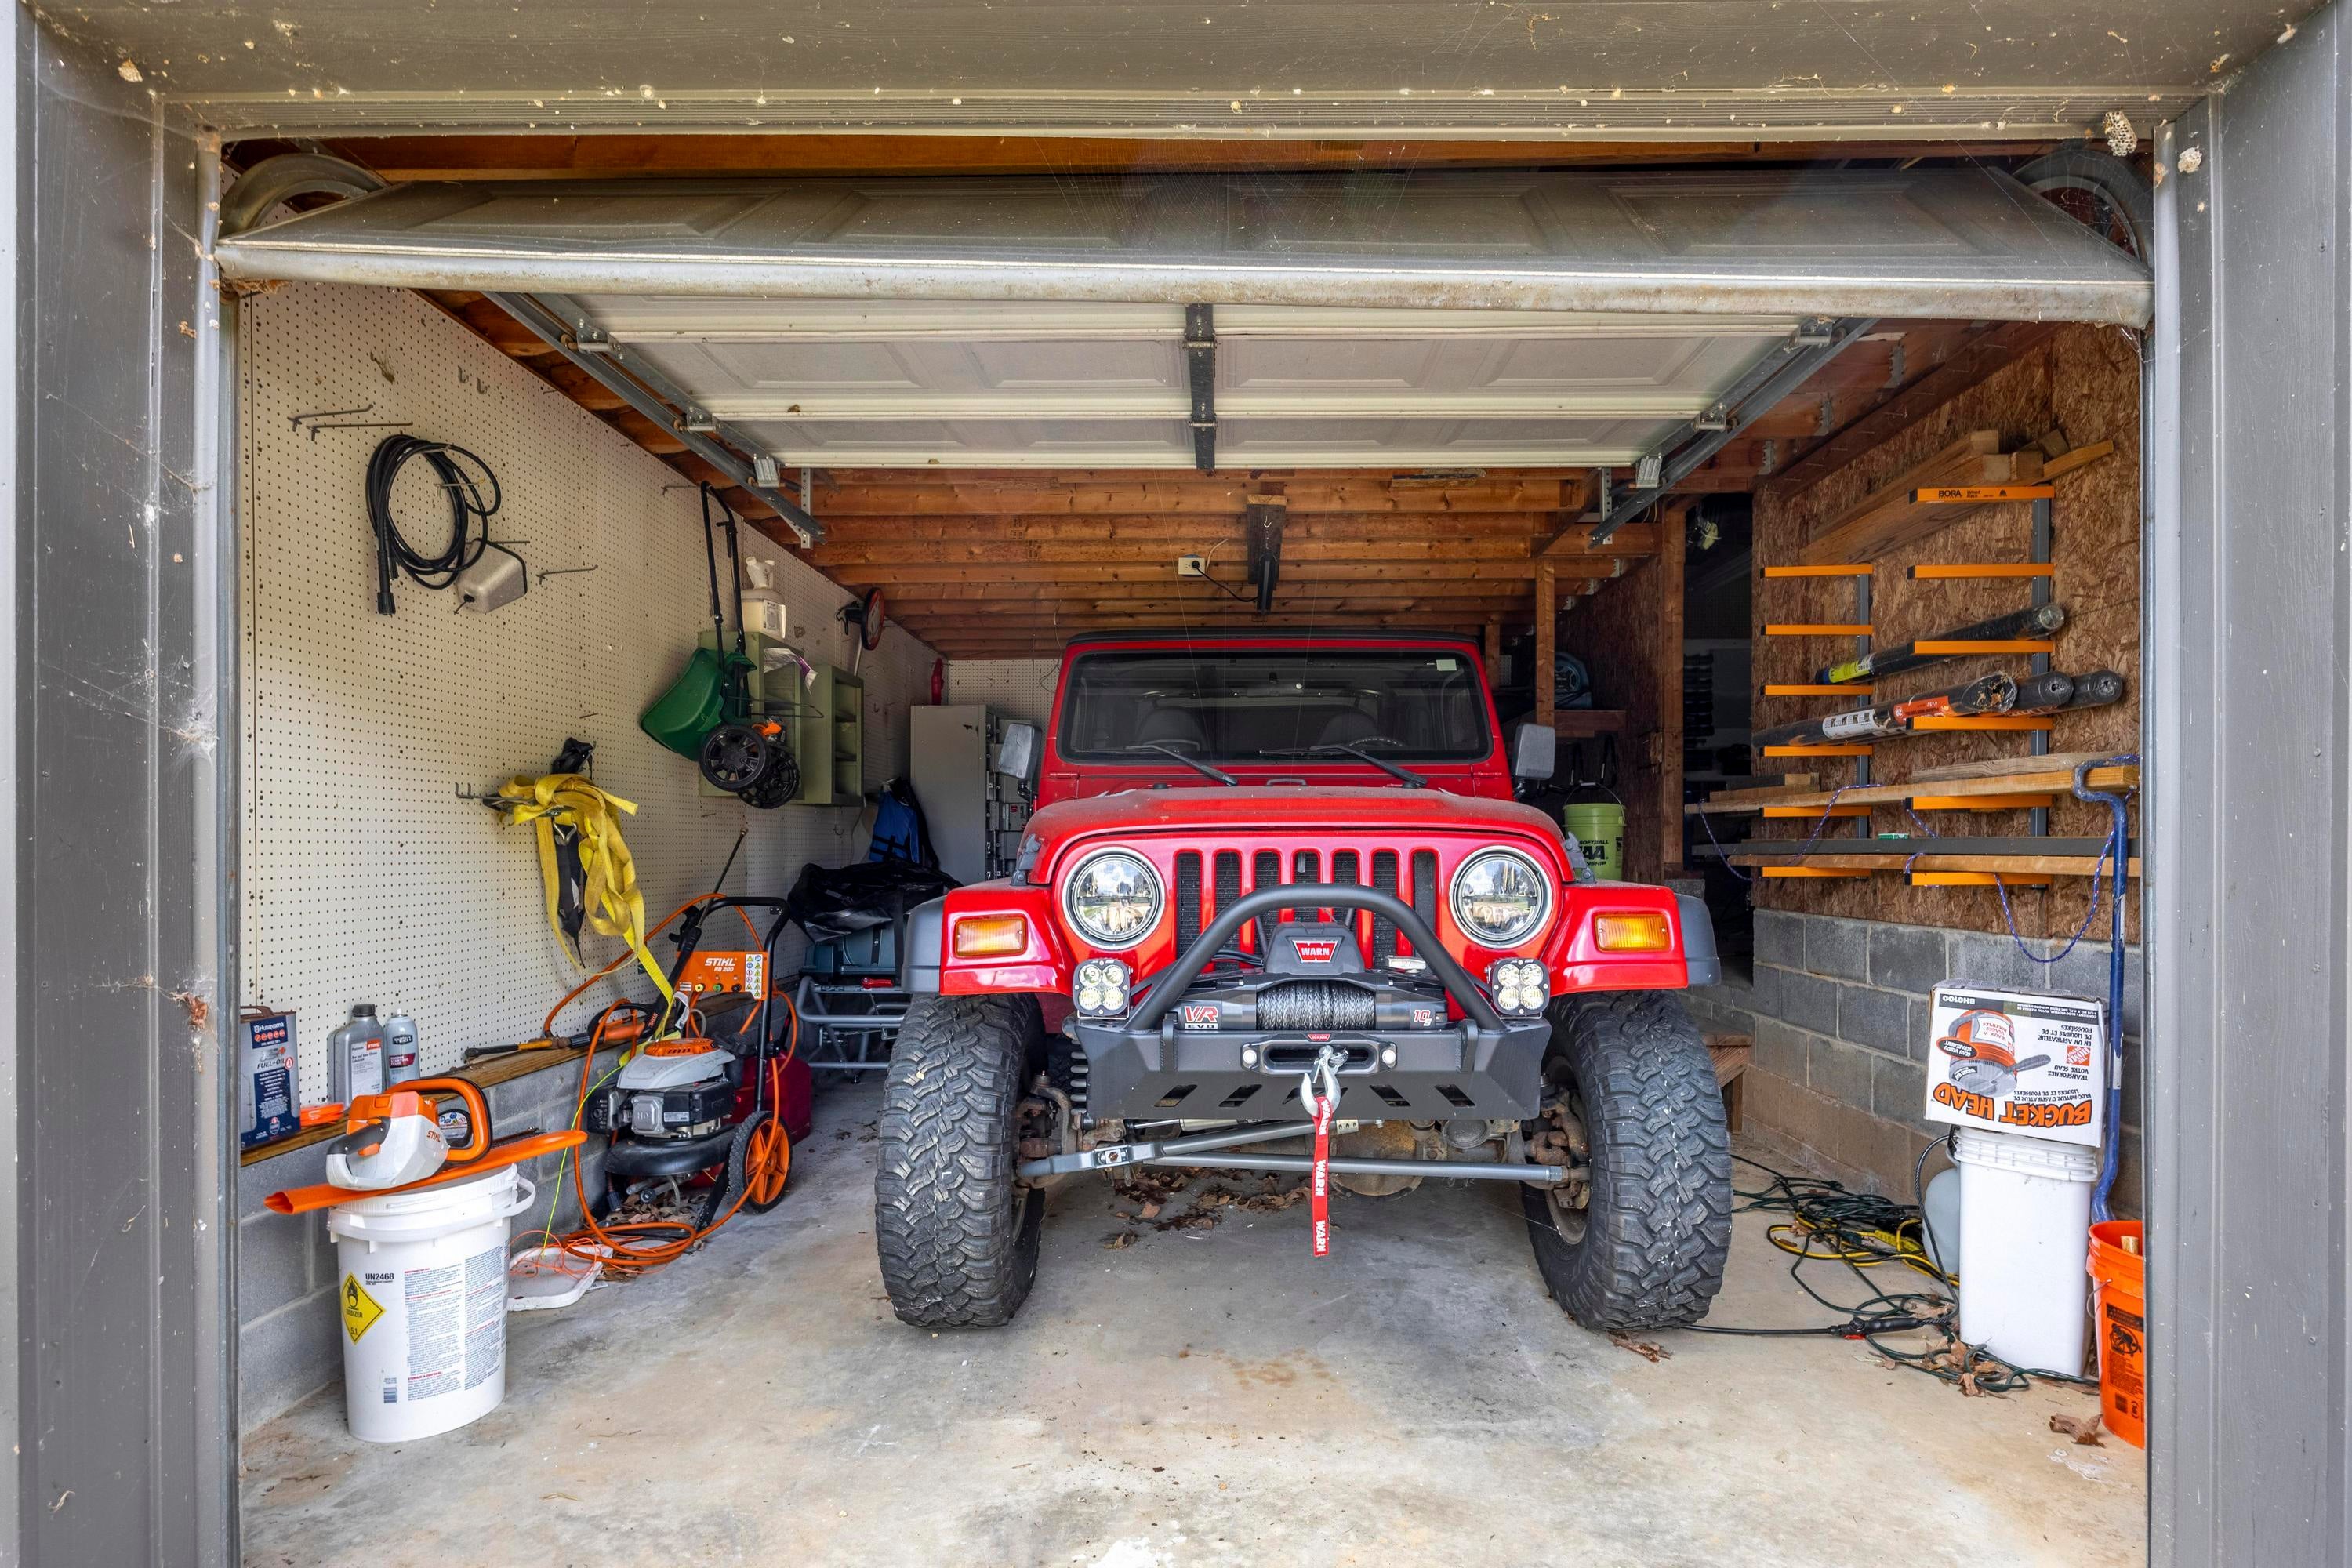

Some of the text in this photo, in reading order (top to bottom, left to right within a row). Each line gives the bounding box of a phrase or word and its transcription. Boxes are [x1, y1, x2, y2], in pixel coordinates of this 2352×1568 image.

[1938, 489, 1962, 498] BORA
[1301, 947, 1330, 956] WARN
[704, 957, 735, 966] STIHL
[1184, 1006, 1219, 1023] VR
[260, 1022, 284, 1032] Husqvarna
[2038, 1035, 2072, 1044] ASPIRATEUR
[257, 1058, 285, 1069] FUEL+OIL
[2047, 1070, 2089, 1081] TRANSFORMEZ
[1933, 1082, 2092, 1128] BUCKET HEAD
[1318, 1100, 1331, 1136] WARN
[426, 1130, 441, 1142] STIHL
[1315, 1159, 1326, 1196] WARN
[1316, 1220, 1326, 1252] WARN
